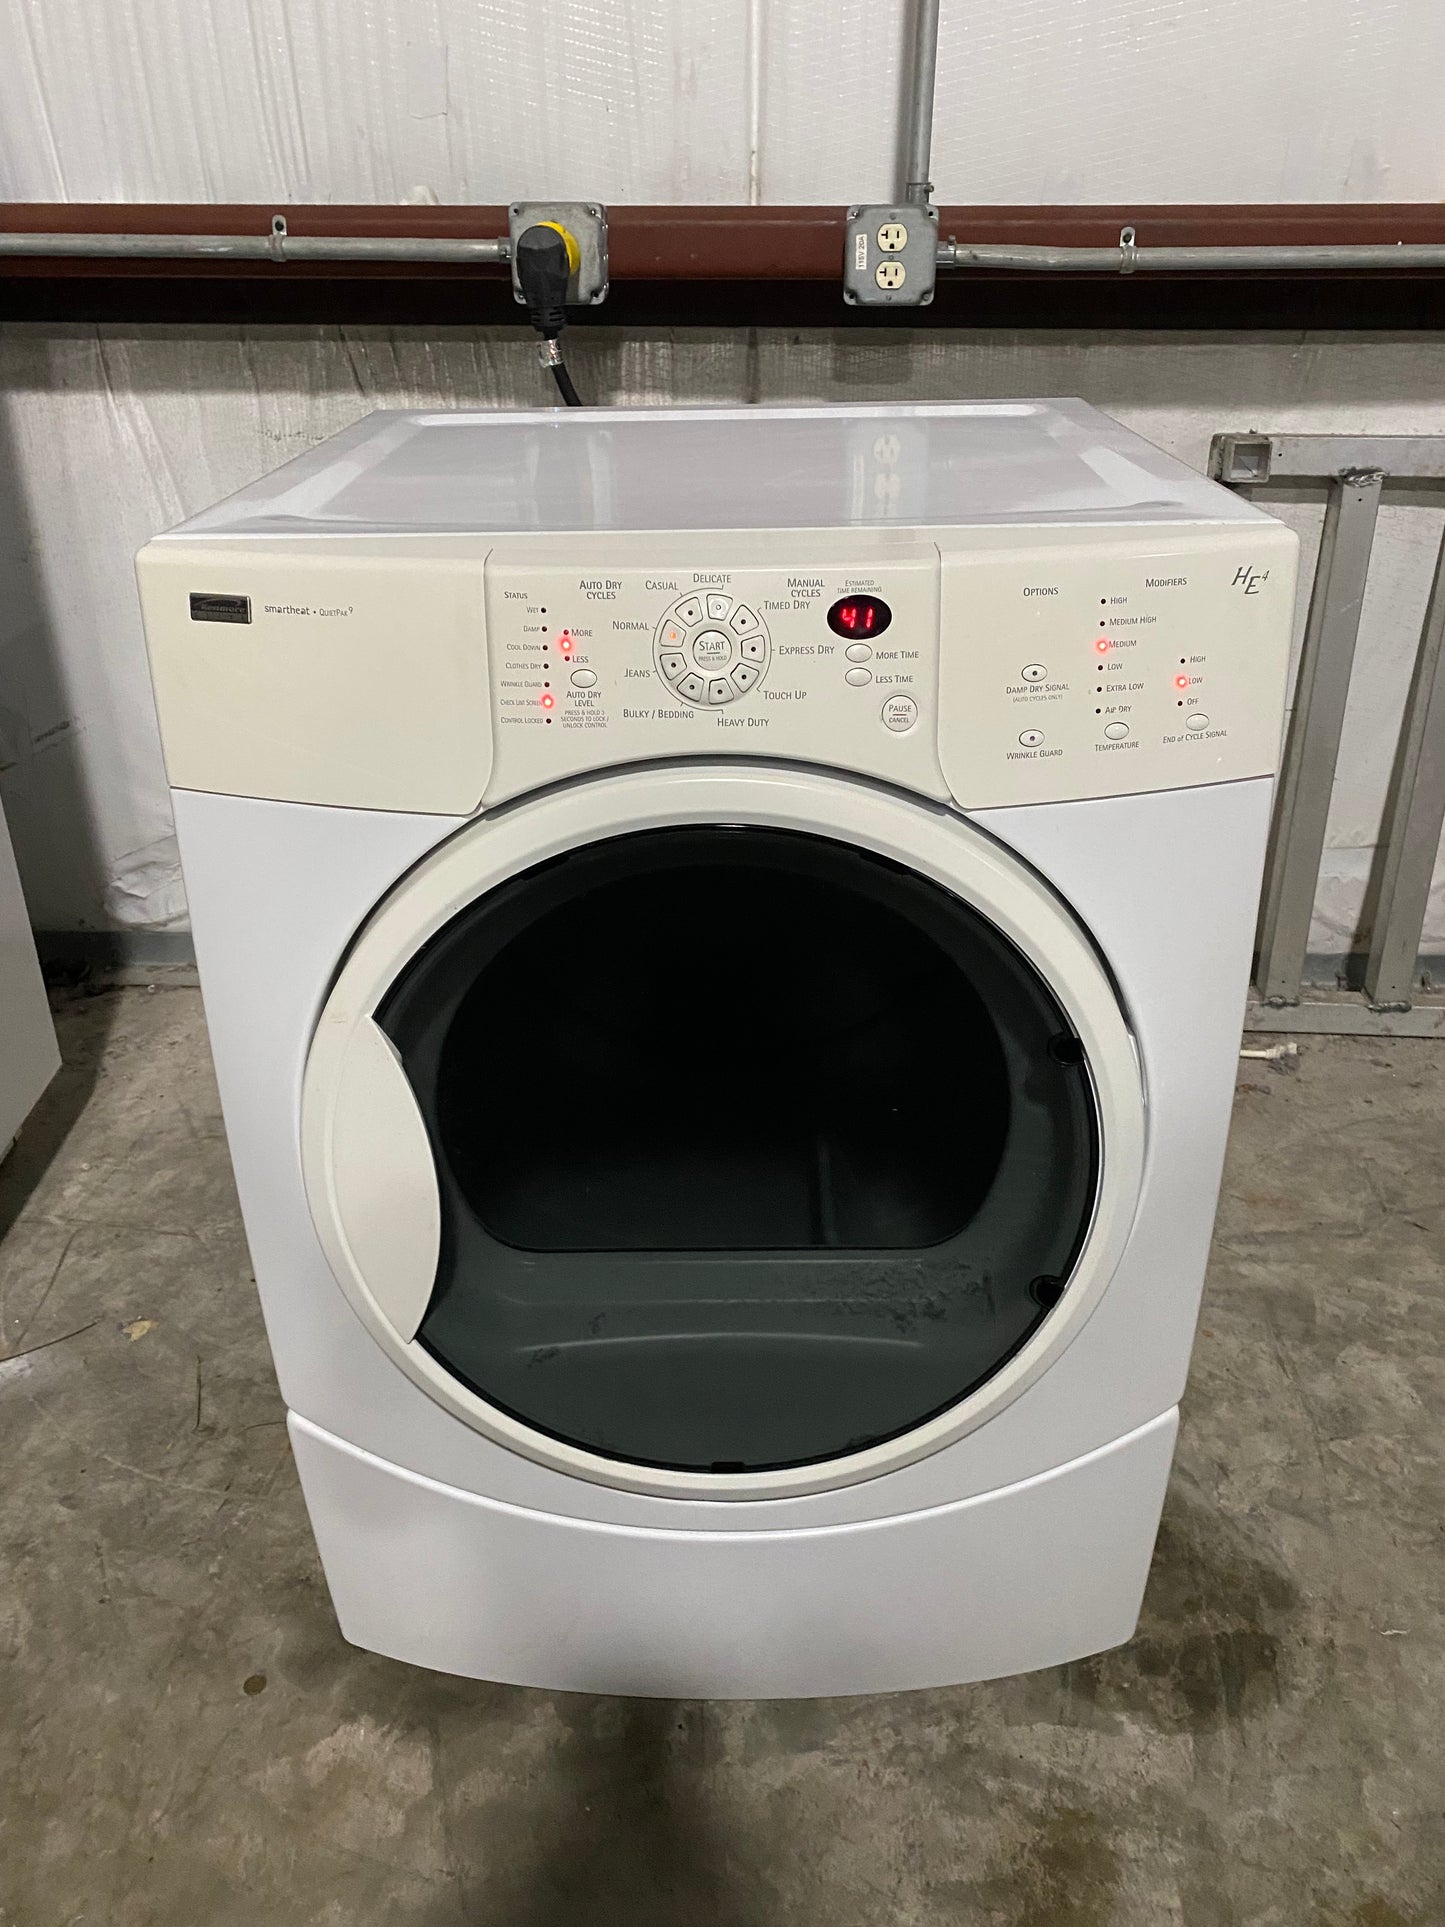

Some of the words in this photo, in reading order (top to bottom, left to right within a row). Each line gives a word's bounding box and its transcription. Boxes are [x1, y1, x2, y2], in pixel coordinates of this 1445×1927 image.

[693, 573, 731, 583] DELICATE
[787, 578, 825, 587] MANUAL
[1145, 577, 1187, 588] MODIFIERS
[579, 580, 602, 590] AUTO
[605, 580, 622, 590] DRY
[645, 580, 679, 590] CASUAL
[504, 591, 528, 599] STATUS
[587, 591, 616, 600] CYCLES
[791, 589, 821, 598] CYCLES
[1023, 587, 1059, 597] OPTIONS
[1110, 596, 1128, 605] HIGH
[764, 601, 790, 610] TIMED
[793, 601, 811, 610] DRY
[264, 605, 310, 616] smartheat
[841, 607, 874, 629] 41
[1109, 617, 1138, 627] MEDIUM
[1139, 615, 1157, 625] HIGH
[612, 621, 650, 630] NORMAL
[571, 628, 593, 637] MORE
[699, 641, 725, 651] START
[1109, 639, 1137, 648] MEDIUM
[779, 645, 815, 655] EXPRESS
[818, 645, 835, 655] DRY
[572, 655, 589, 663] LESS
[875, 651, 898, 660] MORE
[901, 651, 919, 659] TIME
[1189, 655, 1206, 664] HIGH
[1107, 663, 1123, 671] LOW
[624, 669, 650, 678] JEANS
[875, 675, 893, 684] LESS
[895, 675, 913, 683] TIME
[1188, 676, 1203, 685] LOW
[1006, 686, 1028, 695] DAMP
[1029, 685, 1044, 693] DRY
[1045, 684, 1070, 692] SIGNAL
[1106, 684, 1127, 693] EXTRA
[1128, 682, 1145, 691] LOW
[764, 691, 792, 700] TOUCH
[794, 690, 807, 700] UP
[1187, 698, 1199, 706] OFF
[888, 704, 912, 713] PAUSE
[1118, 705, 1132, 713] DRY
[623, 709, 649, 718] BULKY
[658, 709, 694, 719] BEDDING
[717, 717, 744, 727] HEAVY
[747, 717, 770, 727] DUTY
[1162, 735, 1176, 744] END
[1185, 732, 1204, 742] CYCLE
[1205, 730, 1227, 739] SIGNAL
[1095, 741, 1140, 752] TEMPERATURE
[1006, 751, 1038, 761] WRINKLE
[1039, 749, 1063, 758] GUARD
